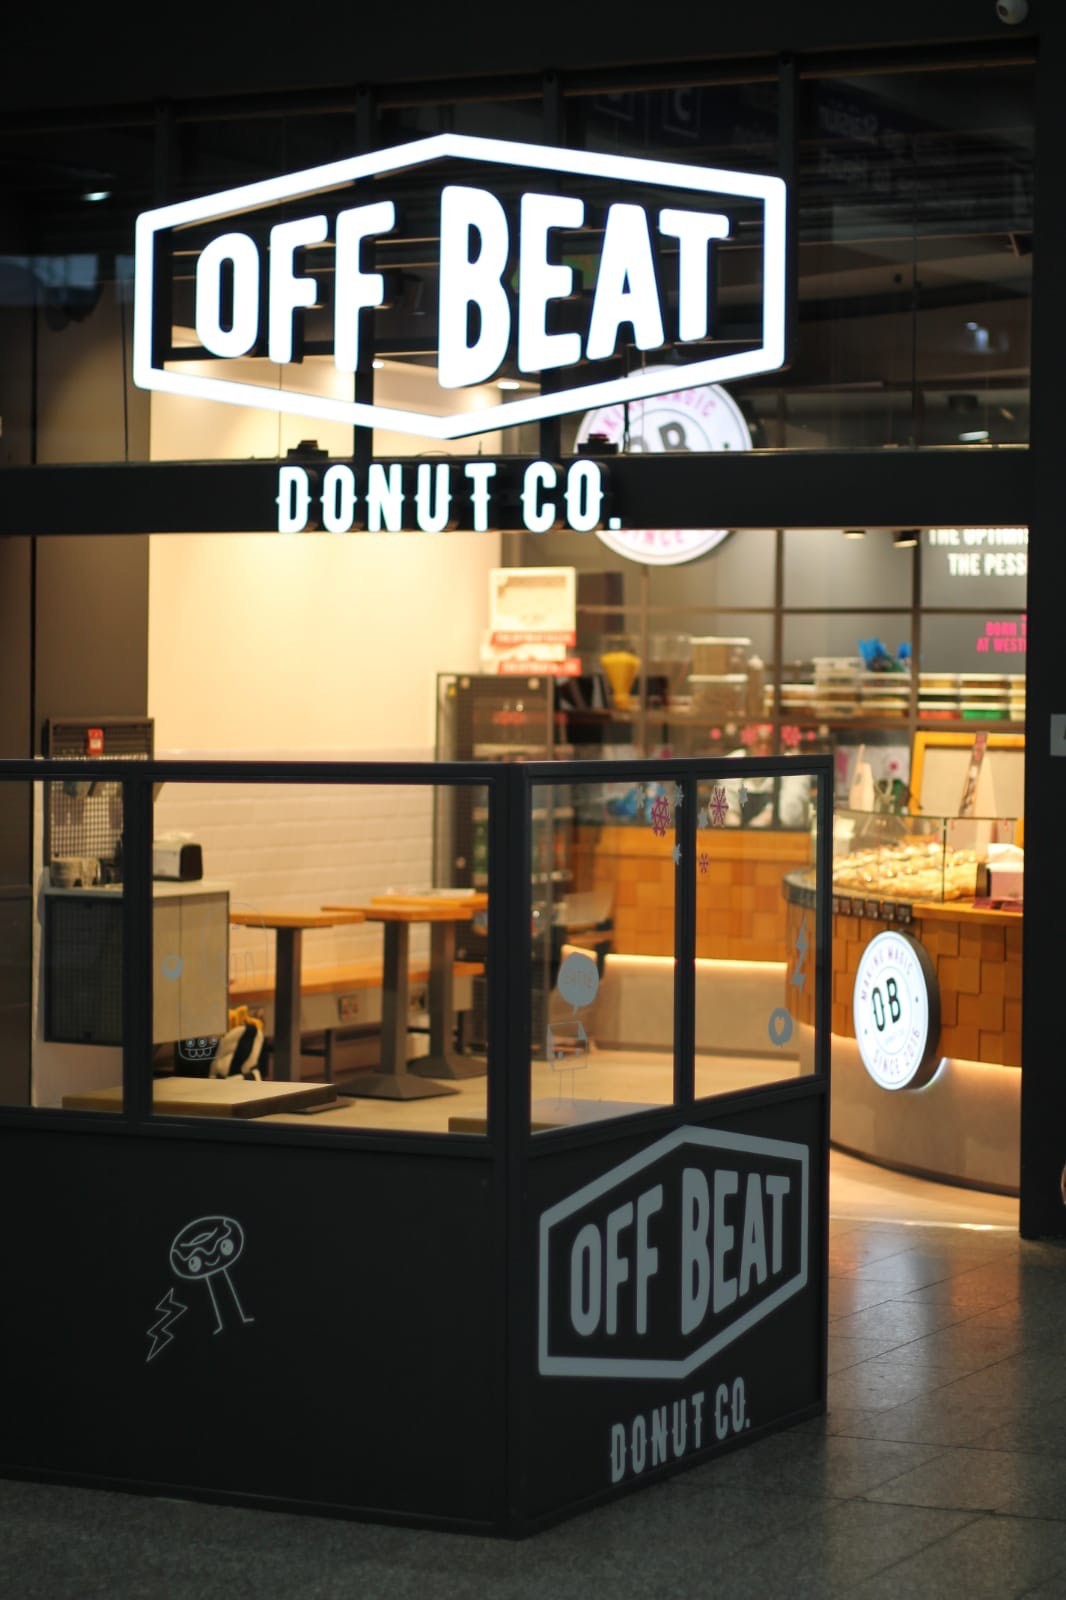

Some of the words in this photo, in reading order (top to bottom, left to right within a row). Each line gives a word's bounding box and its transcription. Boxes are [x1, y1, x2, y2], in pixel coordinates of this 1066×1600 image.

[195, 200, 396, 373] OFF
[438, 185, 730, 389] BEAT
[276, 461, 498, 534] DONUT
[521, 459, 622, 533] CO.
[948, 553, 981, 576] THE
[872, 976, 901, 1032] OB
[570, 1183, 663, 1336] OFF
[681, 1167, 790, 1336] BEAT
[610, 1391, 705, 1483] DONUT
[714, 1376, 750, 1440] CO.
